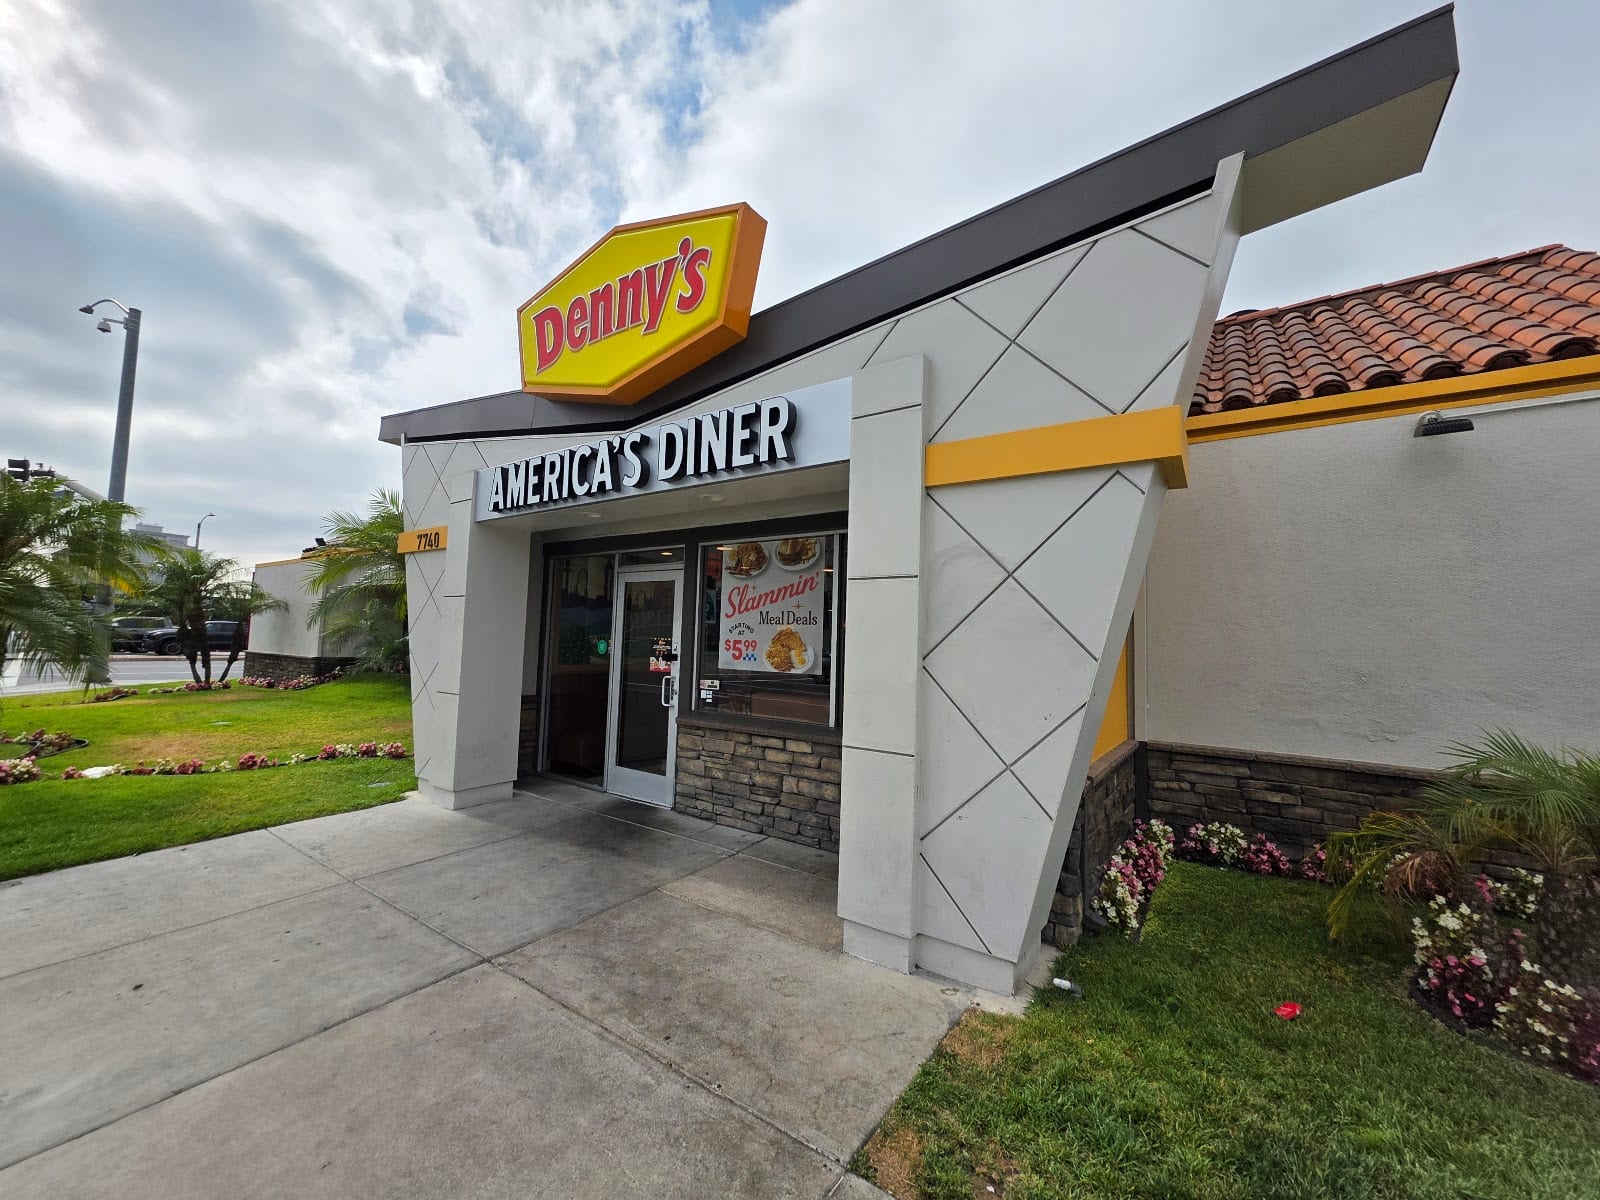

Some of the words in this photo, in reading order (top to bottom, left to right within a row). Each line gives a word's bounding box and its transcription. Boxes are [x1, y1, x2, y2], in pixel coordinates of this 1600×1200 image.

[531, 236, 711, 375] Denny's
[488, 431, 650, 513] AMERICA'S
[658, 396, 796, 482] DINER
[417, 532, 440, 551] 7740
[725, 572, 820, 619] Slammin'
[728, 622, 755, 634] STARTING
[759, 610, 785, 626] Meal
[786, 610, 818, 626] Deals
